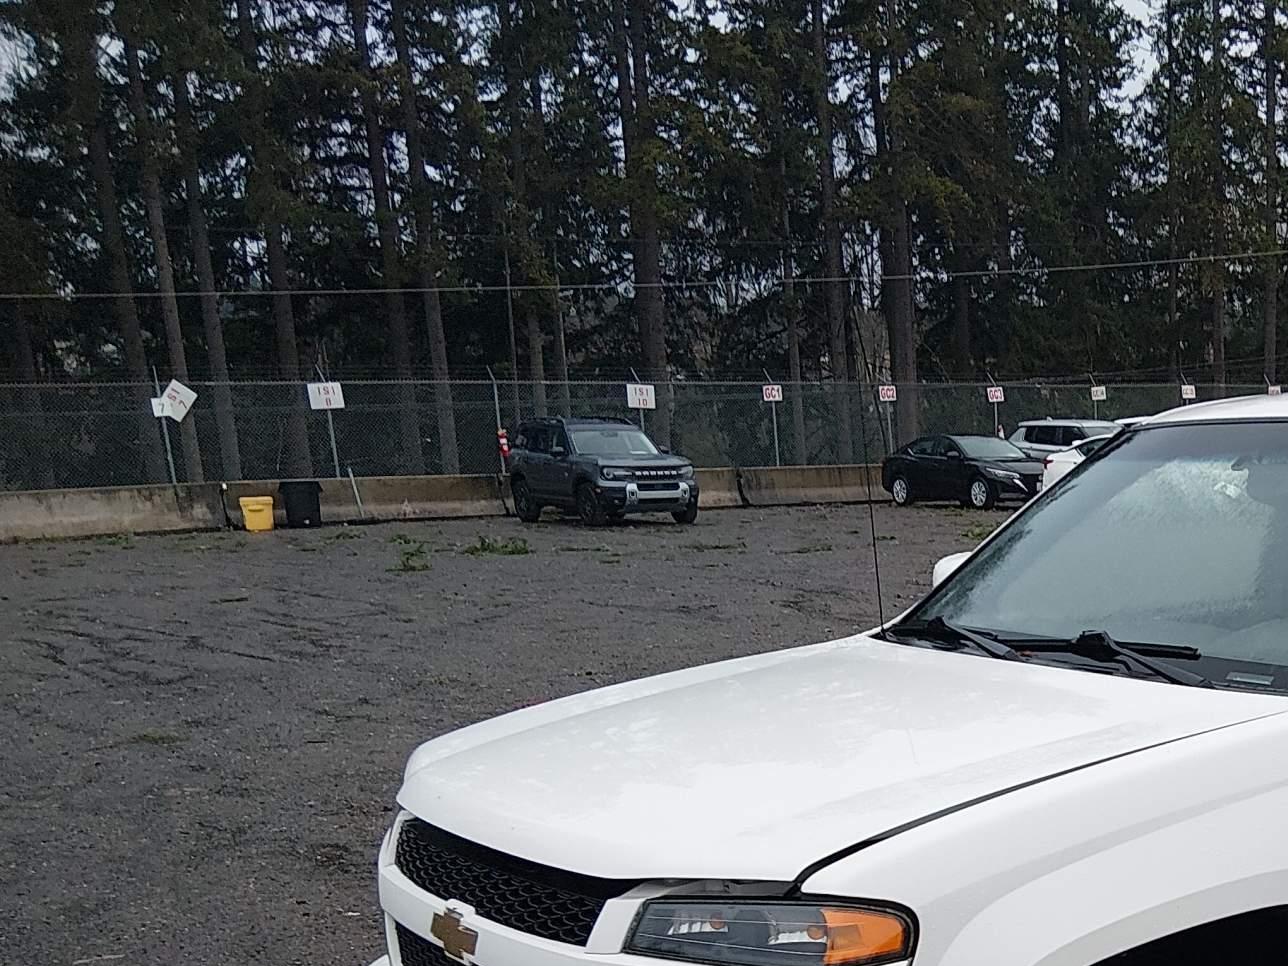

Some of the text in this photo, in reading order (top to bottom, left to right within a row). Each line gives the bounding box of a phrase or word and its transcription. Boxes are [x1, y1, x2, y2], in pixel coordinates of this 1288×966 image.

[764, 385, 781, 399] GC1
[880, 387, 895, 399] GC2
[989, 389, 1003, 400] GC3
